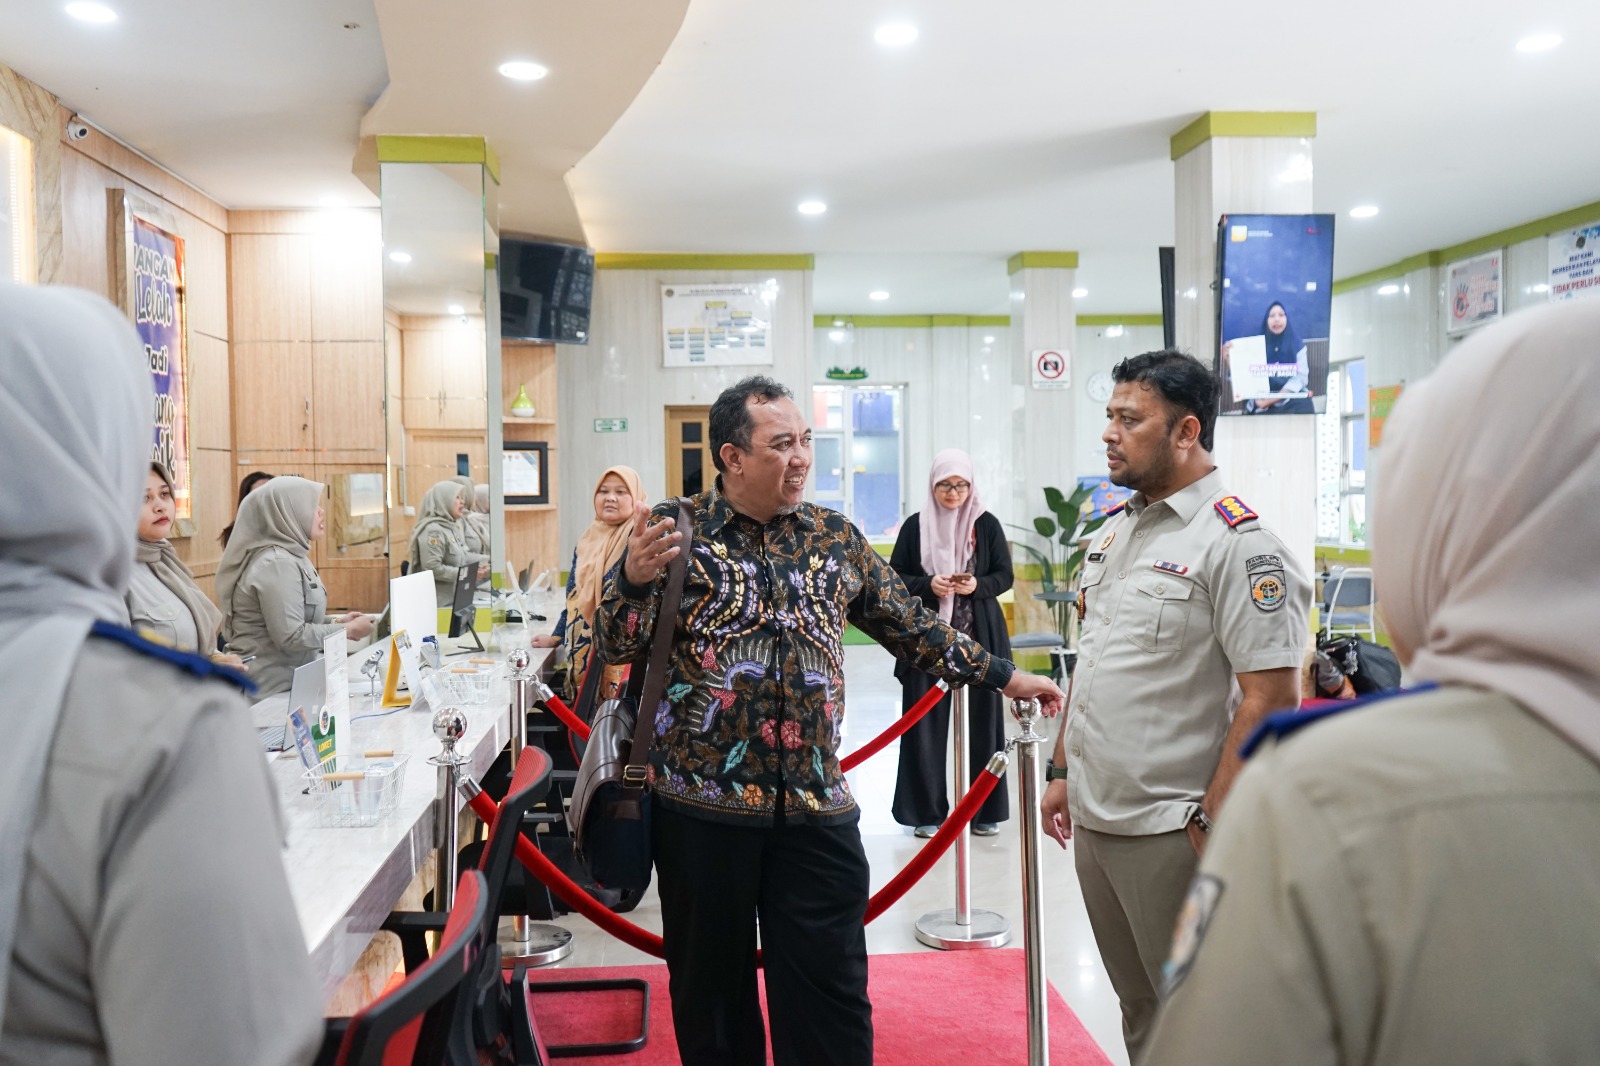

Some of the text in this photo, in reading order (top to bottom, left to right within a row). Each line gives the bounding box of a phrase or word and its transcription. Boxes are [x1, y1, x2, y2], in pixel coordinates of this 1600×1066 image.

[1552, 281, 1571, 295] TIDAK
[1571, 277, 1593, 291] PERLU
[136, 273, 172, 326] Lelah
[145, 344, 169, 376] Jadi
[318, 738, 332, 753] LOKET
